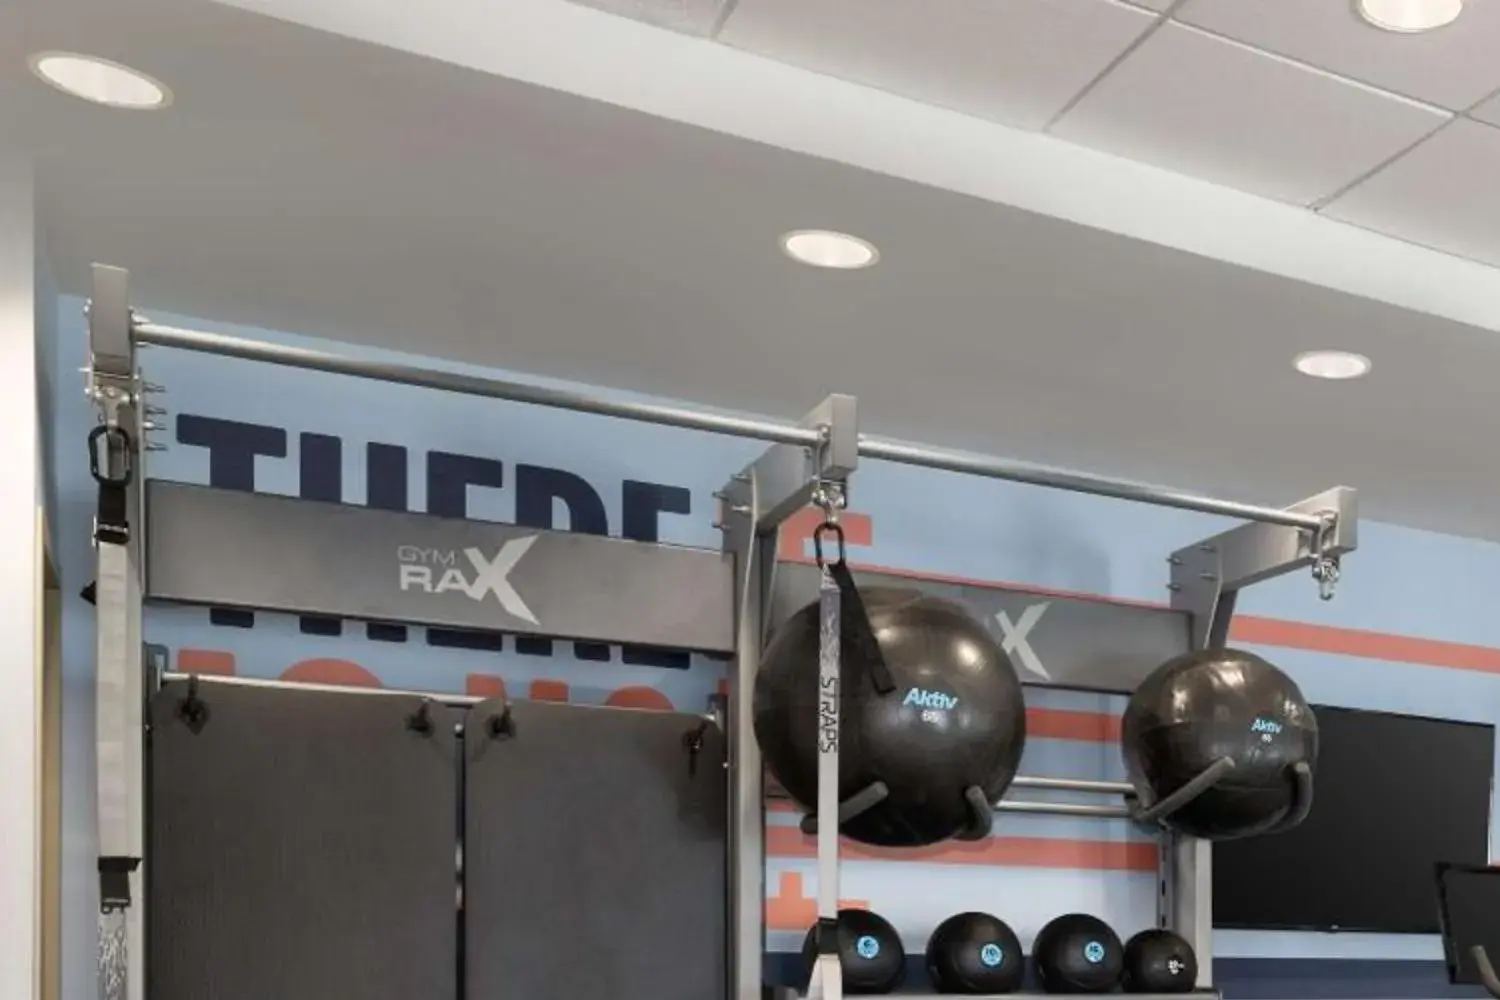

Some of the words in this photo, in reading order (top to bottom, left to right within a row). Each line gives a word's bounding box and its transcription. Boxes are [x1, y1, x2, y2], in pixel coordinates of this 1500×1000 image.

[398, 545, 455, 566] GYM
[903, 687, 959, 710] Aktiv
[819, 676, 838, 754] STRAPS
